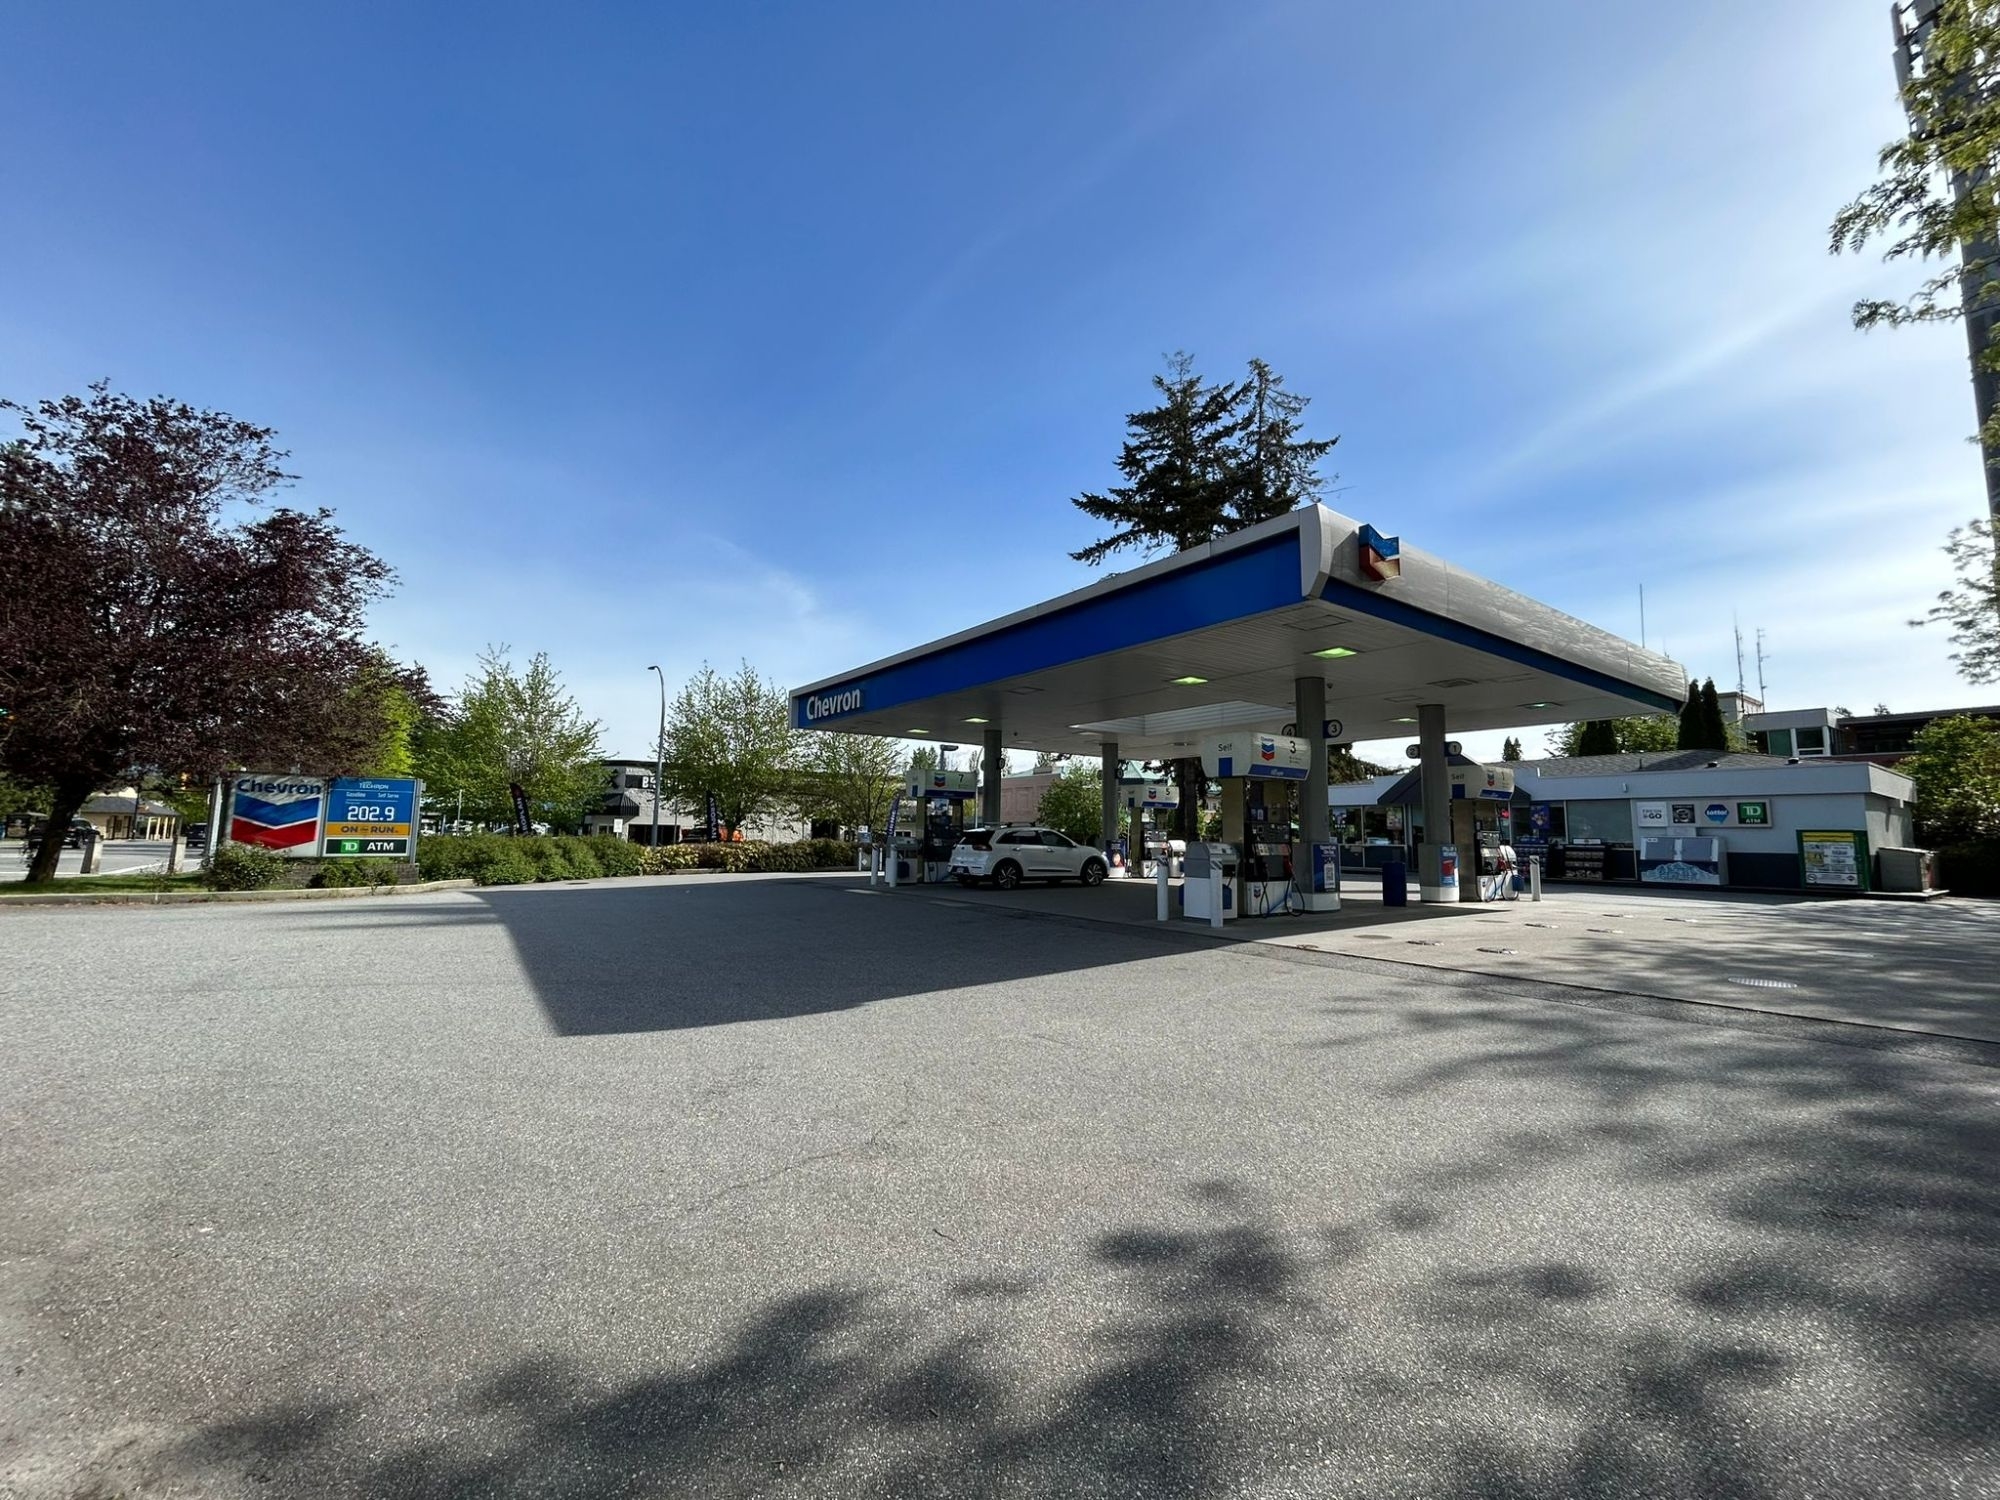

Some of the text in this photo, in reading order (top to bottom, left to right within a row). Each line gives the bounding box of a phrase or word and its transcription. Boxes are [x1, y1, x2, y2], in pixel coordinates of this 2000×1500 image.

[806, 689, 861, 720] Chevron
[1218, 743, 1232, 752] Self
[1289, 740, 1297, 754] 3
[1451, 773, 1465, 781] Self
[237, 779, 322, 794] Chevron
[347, 806, 395, 821] 202.9
[1743, 805, 1761, 816] TD
[341, 825, 358, 833] ON
[370, 825, 394, 833] RUN
[343, 842, 394, 851] TD ATM
